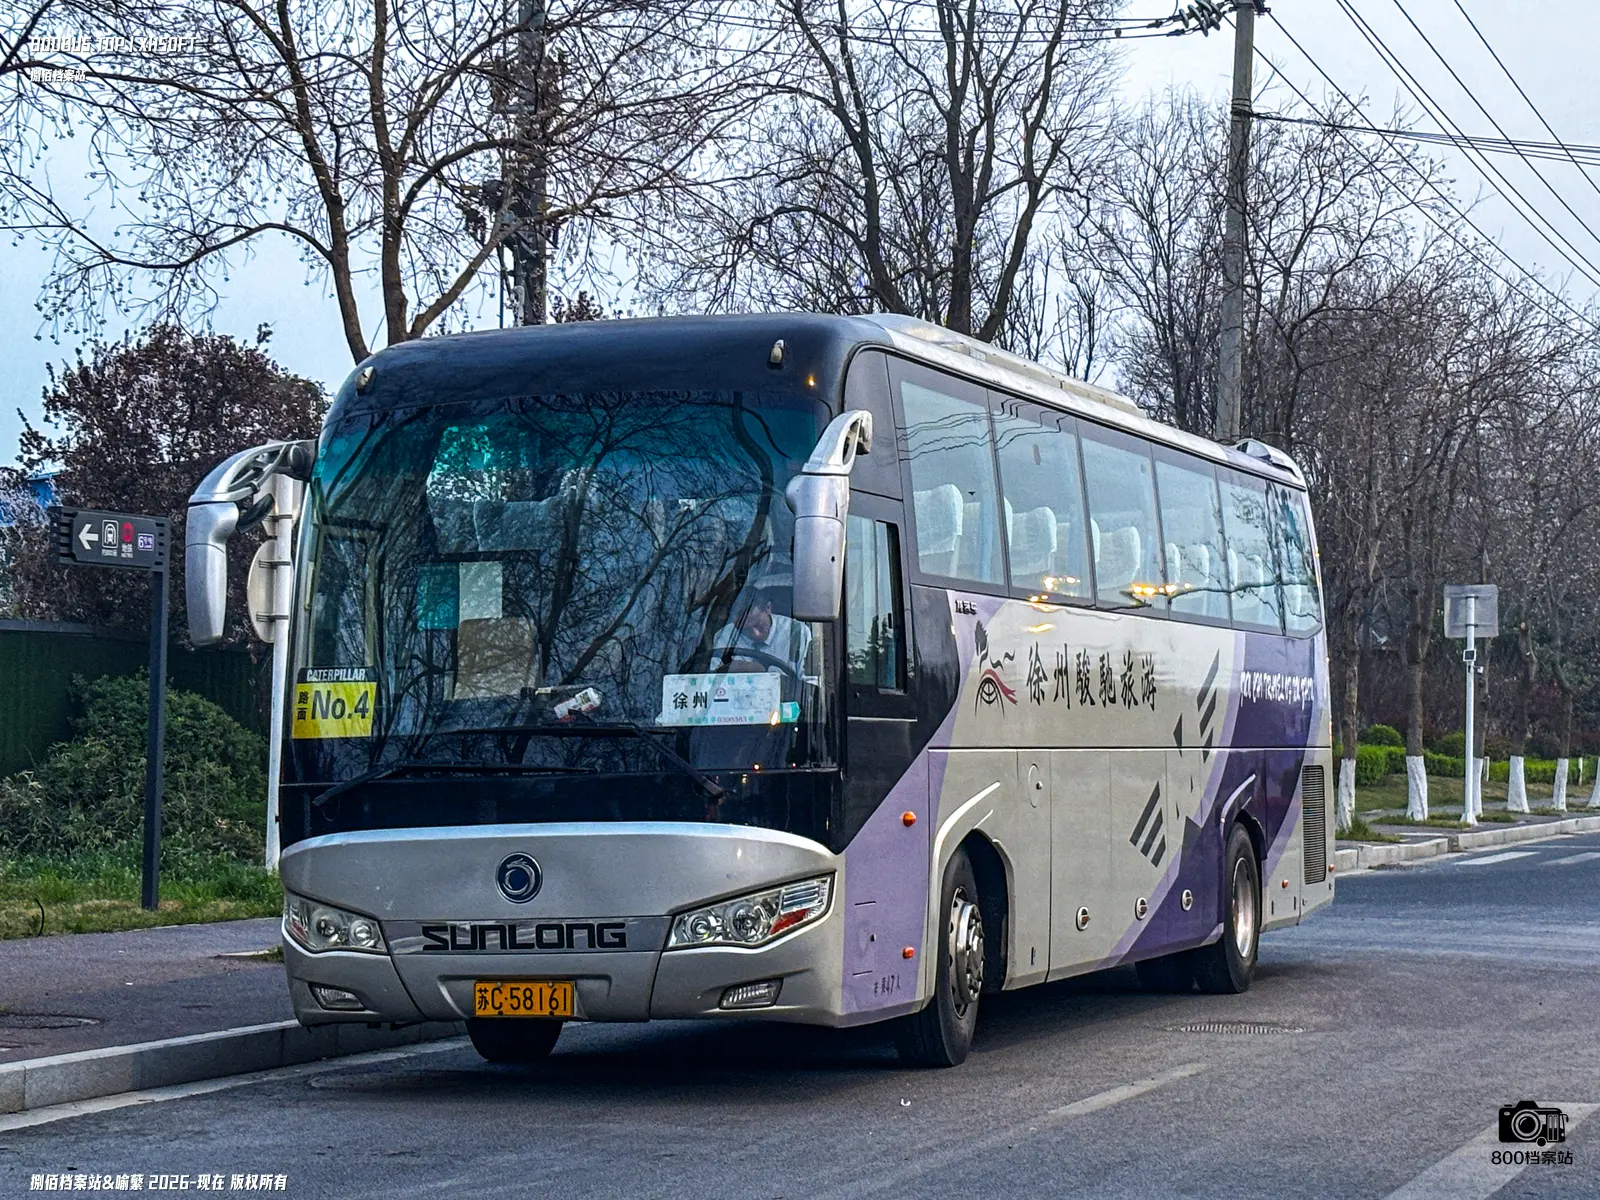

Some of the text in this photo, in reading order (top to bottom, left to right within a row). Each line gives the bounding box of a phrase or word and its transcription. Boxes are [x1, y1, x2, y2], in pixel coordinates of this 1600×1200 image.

[306, 668, 366, 682] CATERPILLAR
[311, 690, 370, 720] No.4
[421, 922, 628, 951] SUNLONG
